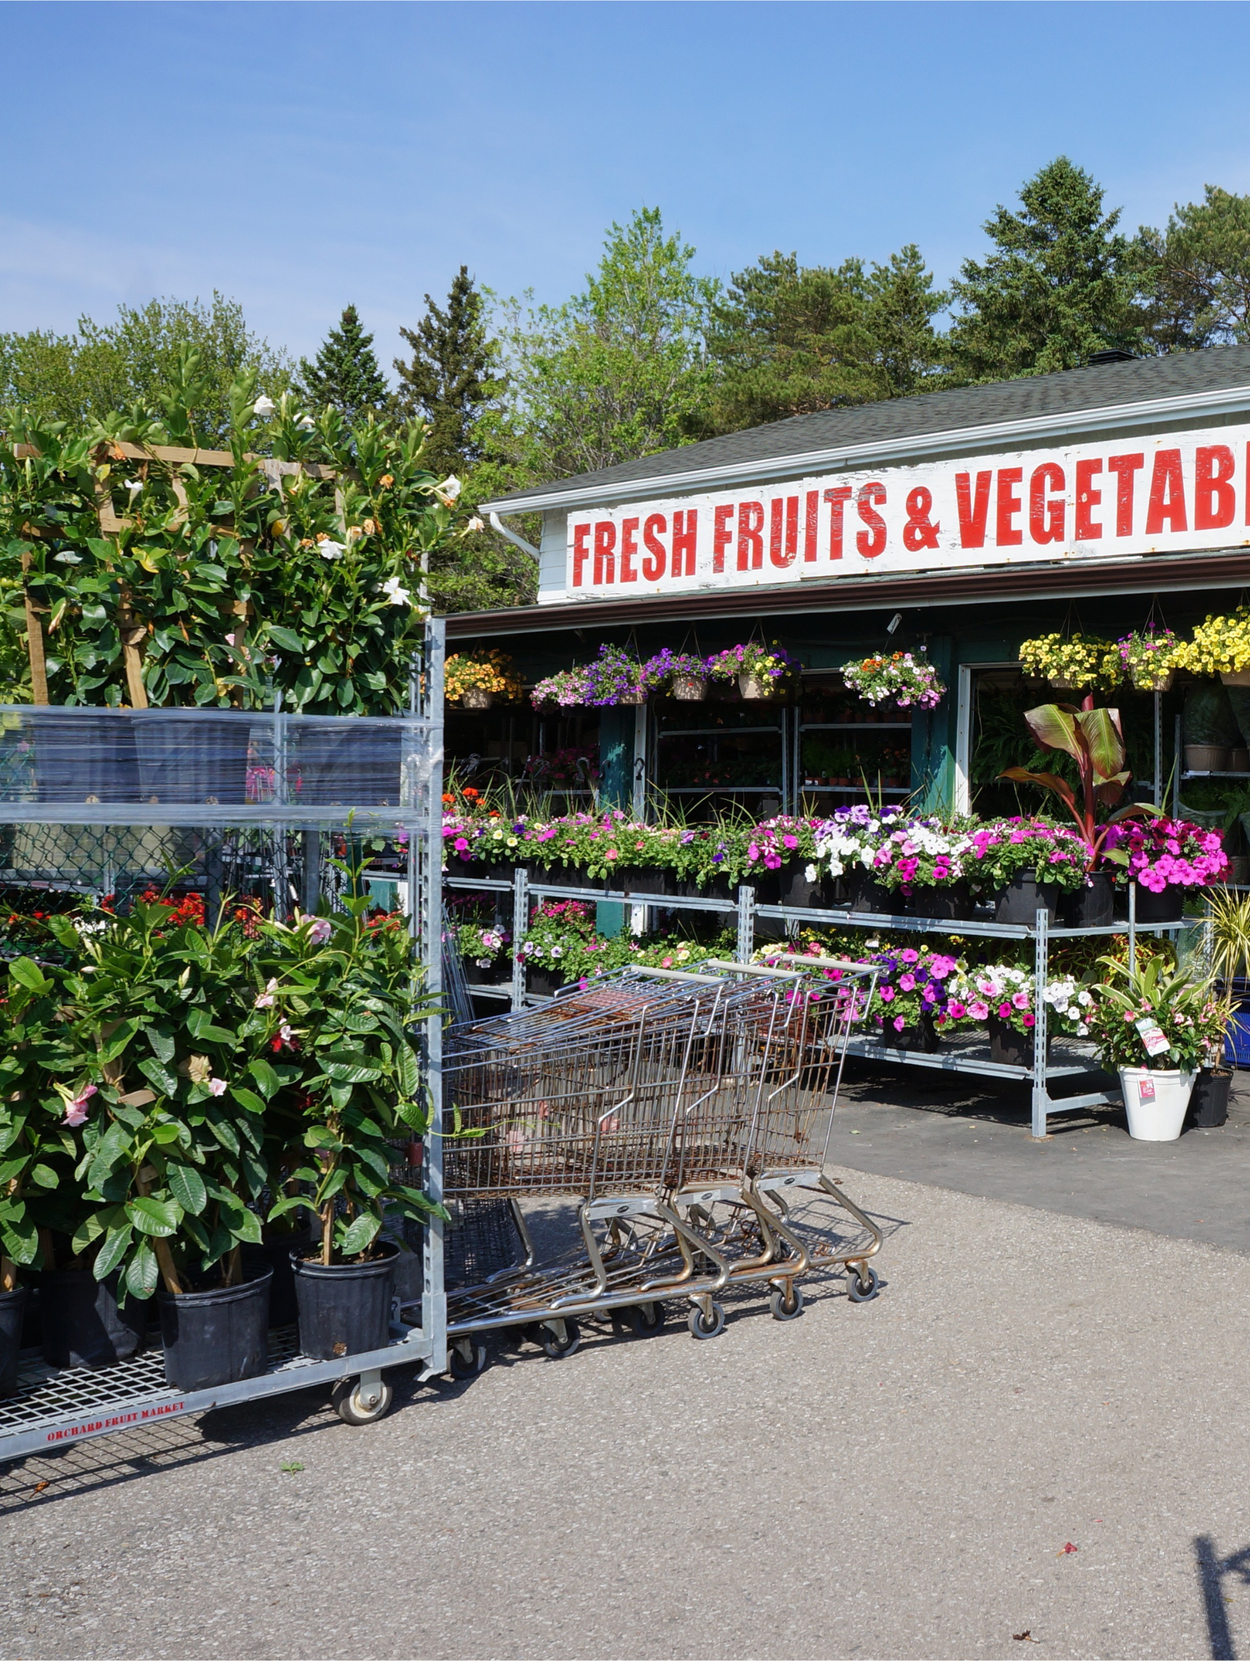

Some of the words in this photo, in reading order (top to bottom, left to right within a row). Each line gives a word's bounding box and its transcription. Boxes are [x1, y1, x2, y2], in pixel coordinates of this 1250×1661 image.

[573, 509, 698, 587] FRESH
[713, 481, 887, 574] FRUITS
[903, 486, 940, 552] &
[47, 1421, 102, 1441] ORCHARD
[105, 1412, 138, 1427] FRUIT
[141, 1401, 185, 1418] MARKET
